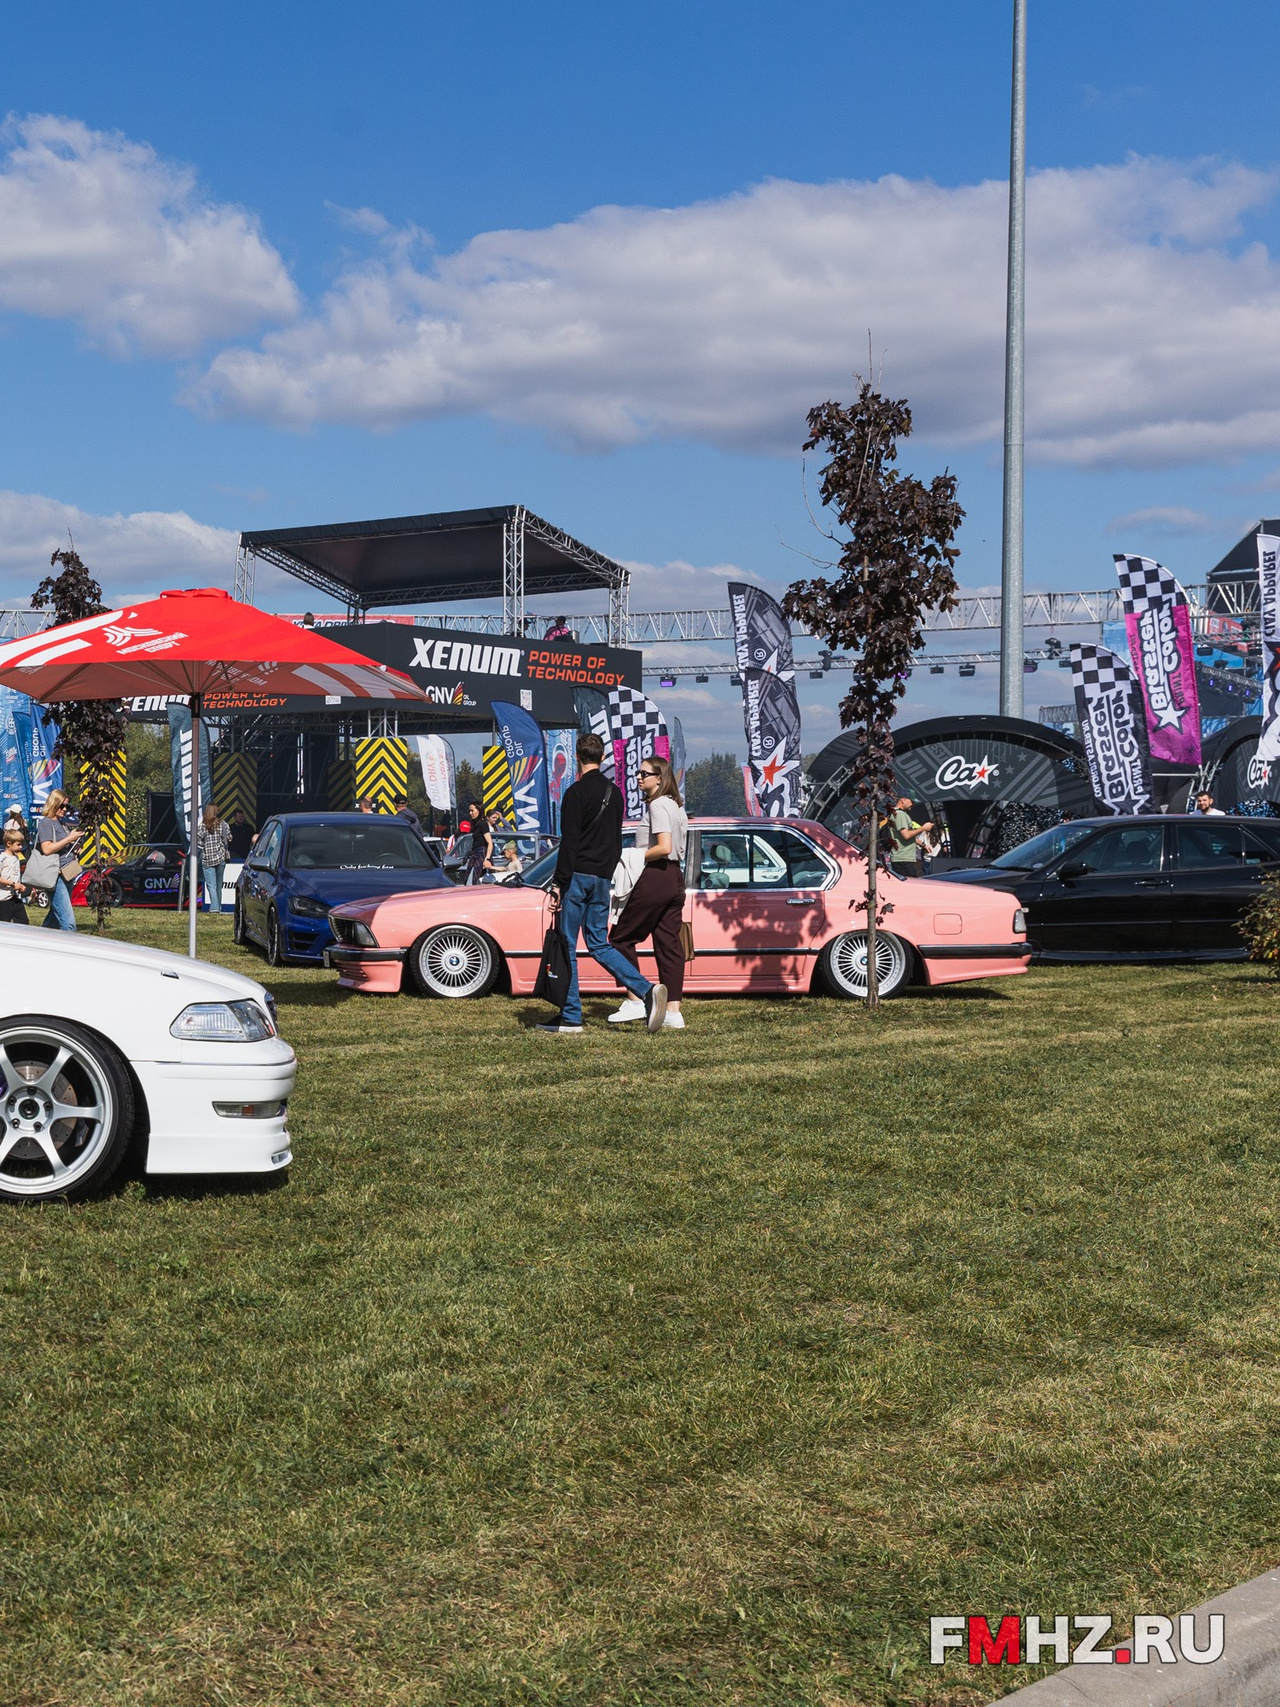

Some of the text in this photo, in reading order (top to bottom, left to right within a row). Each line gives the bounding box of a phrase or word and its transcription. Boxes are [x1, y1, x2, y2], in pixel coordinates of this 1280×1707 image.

[409, 638, 521, 677] XENUM
[529, 650, 606, 669] POWER OF
[527, 666, 625, 686] TECHNOLOGY
[202, 698, 287, 709] TECHNOLOGY
[426, 685, 454, 705] GNV
[144, 877, 171, 889] GNV
